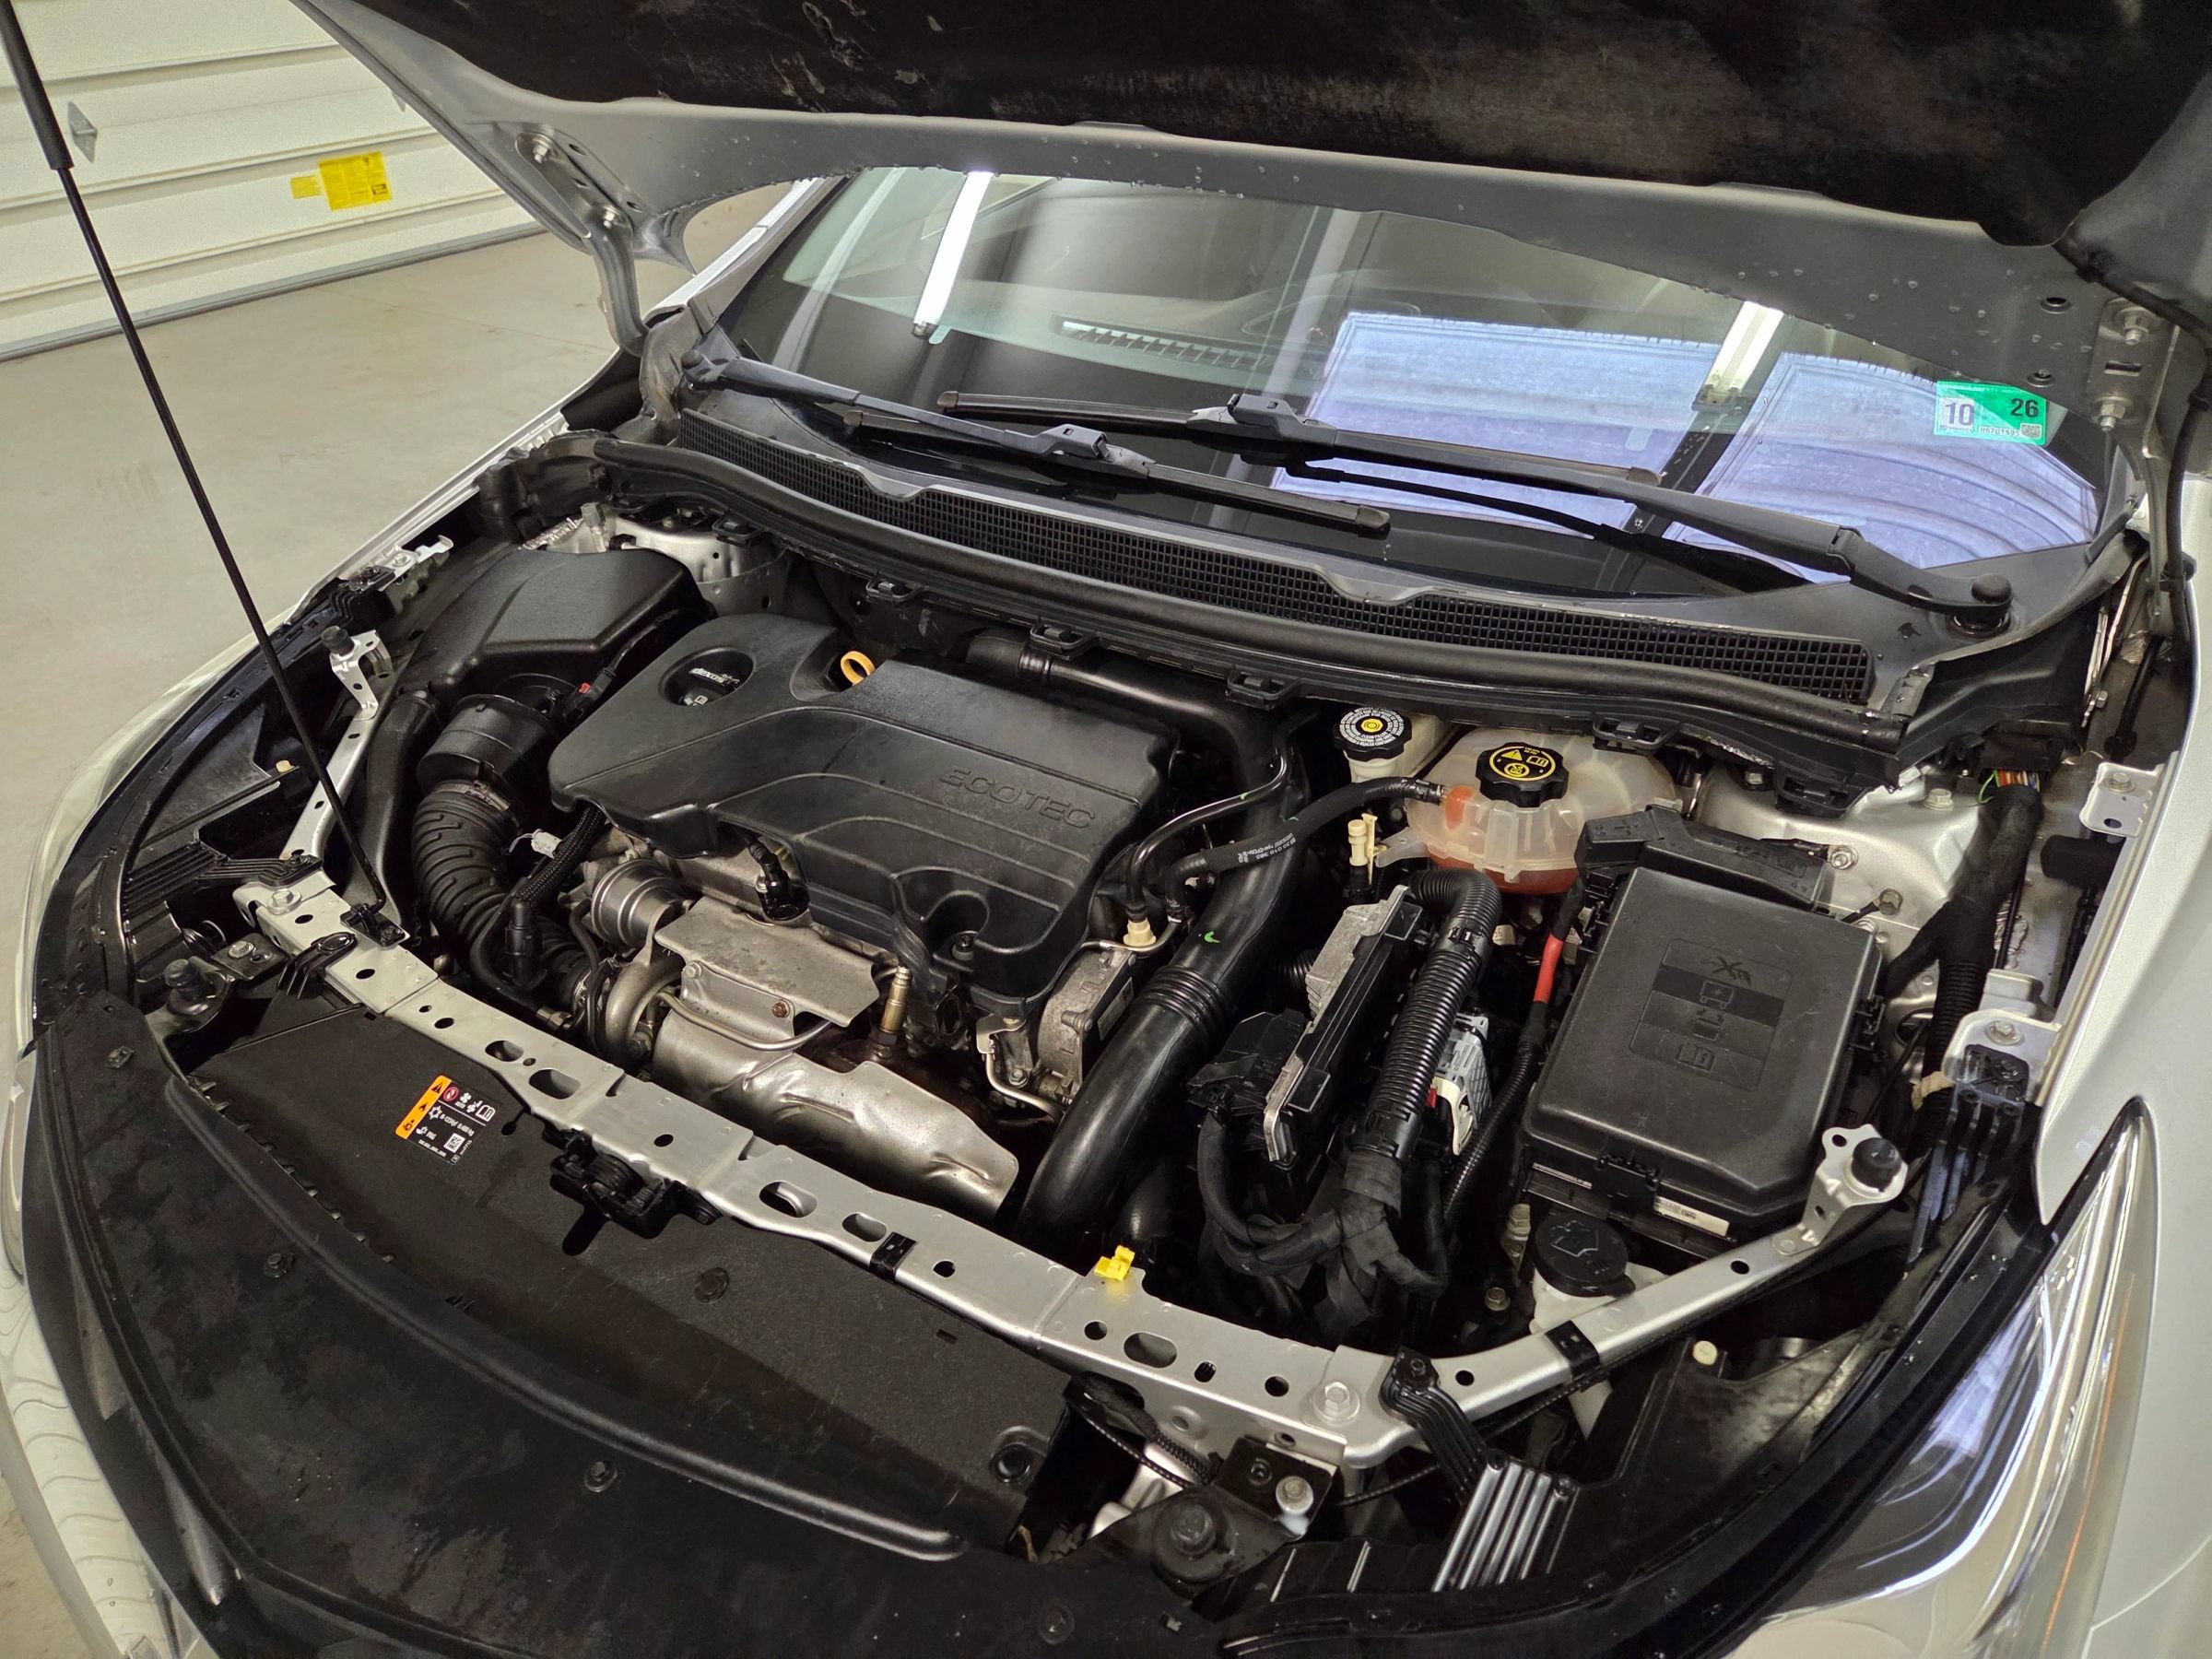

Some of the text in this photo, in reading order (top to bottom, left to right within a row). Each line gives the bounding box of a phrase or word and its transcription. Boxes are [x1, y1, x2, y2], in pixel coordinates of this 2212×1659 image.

[1945, 403, 1975, 426] 10
[2010, 398, 2039, 418] 26
[940, 765, 1096, 830] ECOTEC
